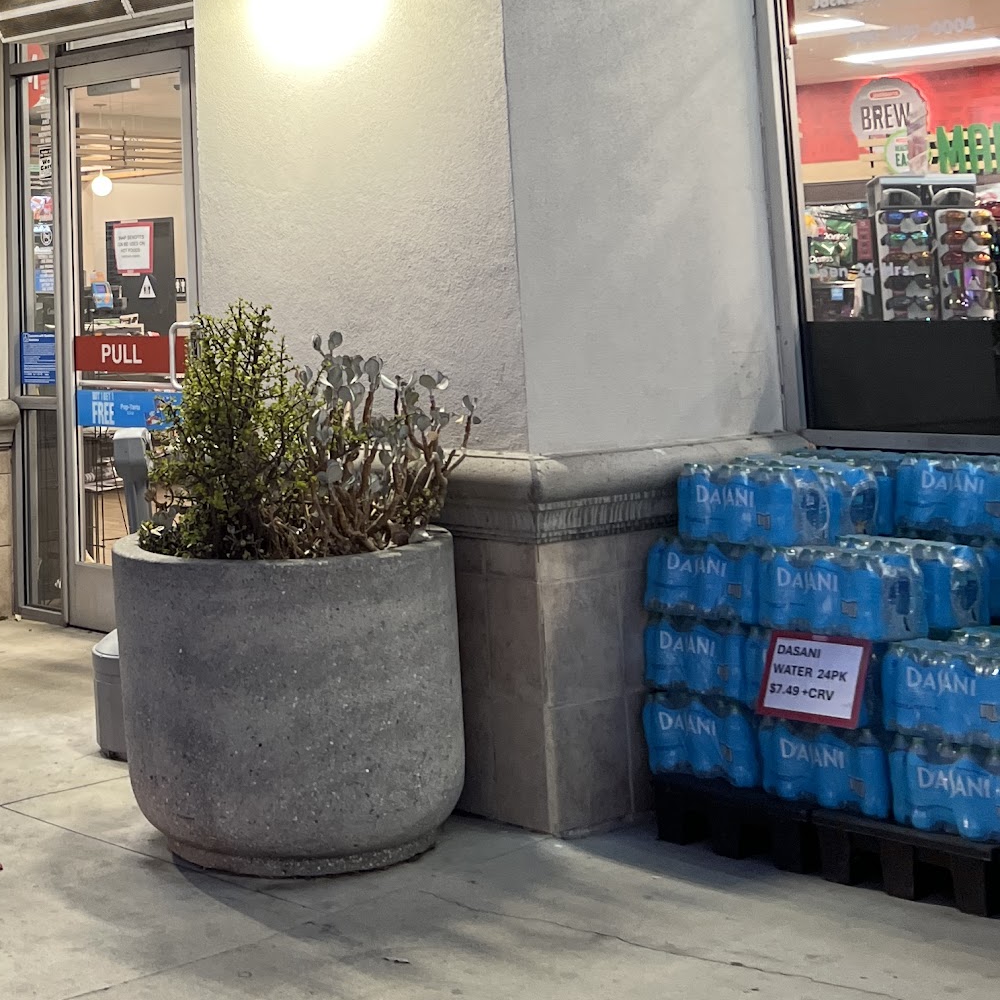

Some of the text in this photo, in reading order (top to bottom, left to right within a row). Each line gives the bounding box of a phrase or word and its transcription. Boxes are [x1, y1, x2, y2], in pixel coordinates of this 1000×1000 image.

[861, 102, 909, 130] BREW
[808, 261, 915, 281] Open 24 Hrs.
[101, 344, 143, 364] PULL
[92, 401, 115, 425] FREE
[922, 470, 984, 495] DASANI
[696, 485, 755, 508] DASANI
[667, 552, 727, 578] DASANI
[777, 566, 838, 594] DASANI
[777, 644, 821, 659] DASANI
[773, 663, 848, 682] WATER 24PK
[906, 666, 976, 697] DASANI
[769, 683, 834, 701] $7.49 +CRV
[779, 737, 845, 769] DASANI
[917, 766, 991, 799] DASANI
